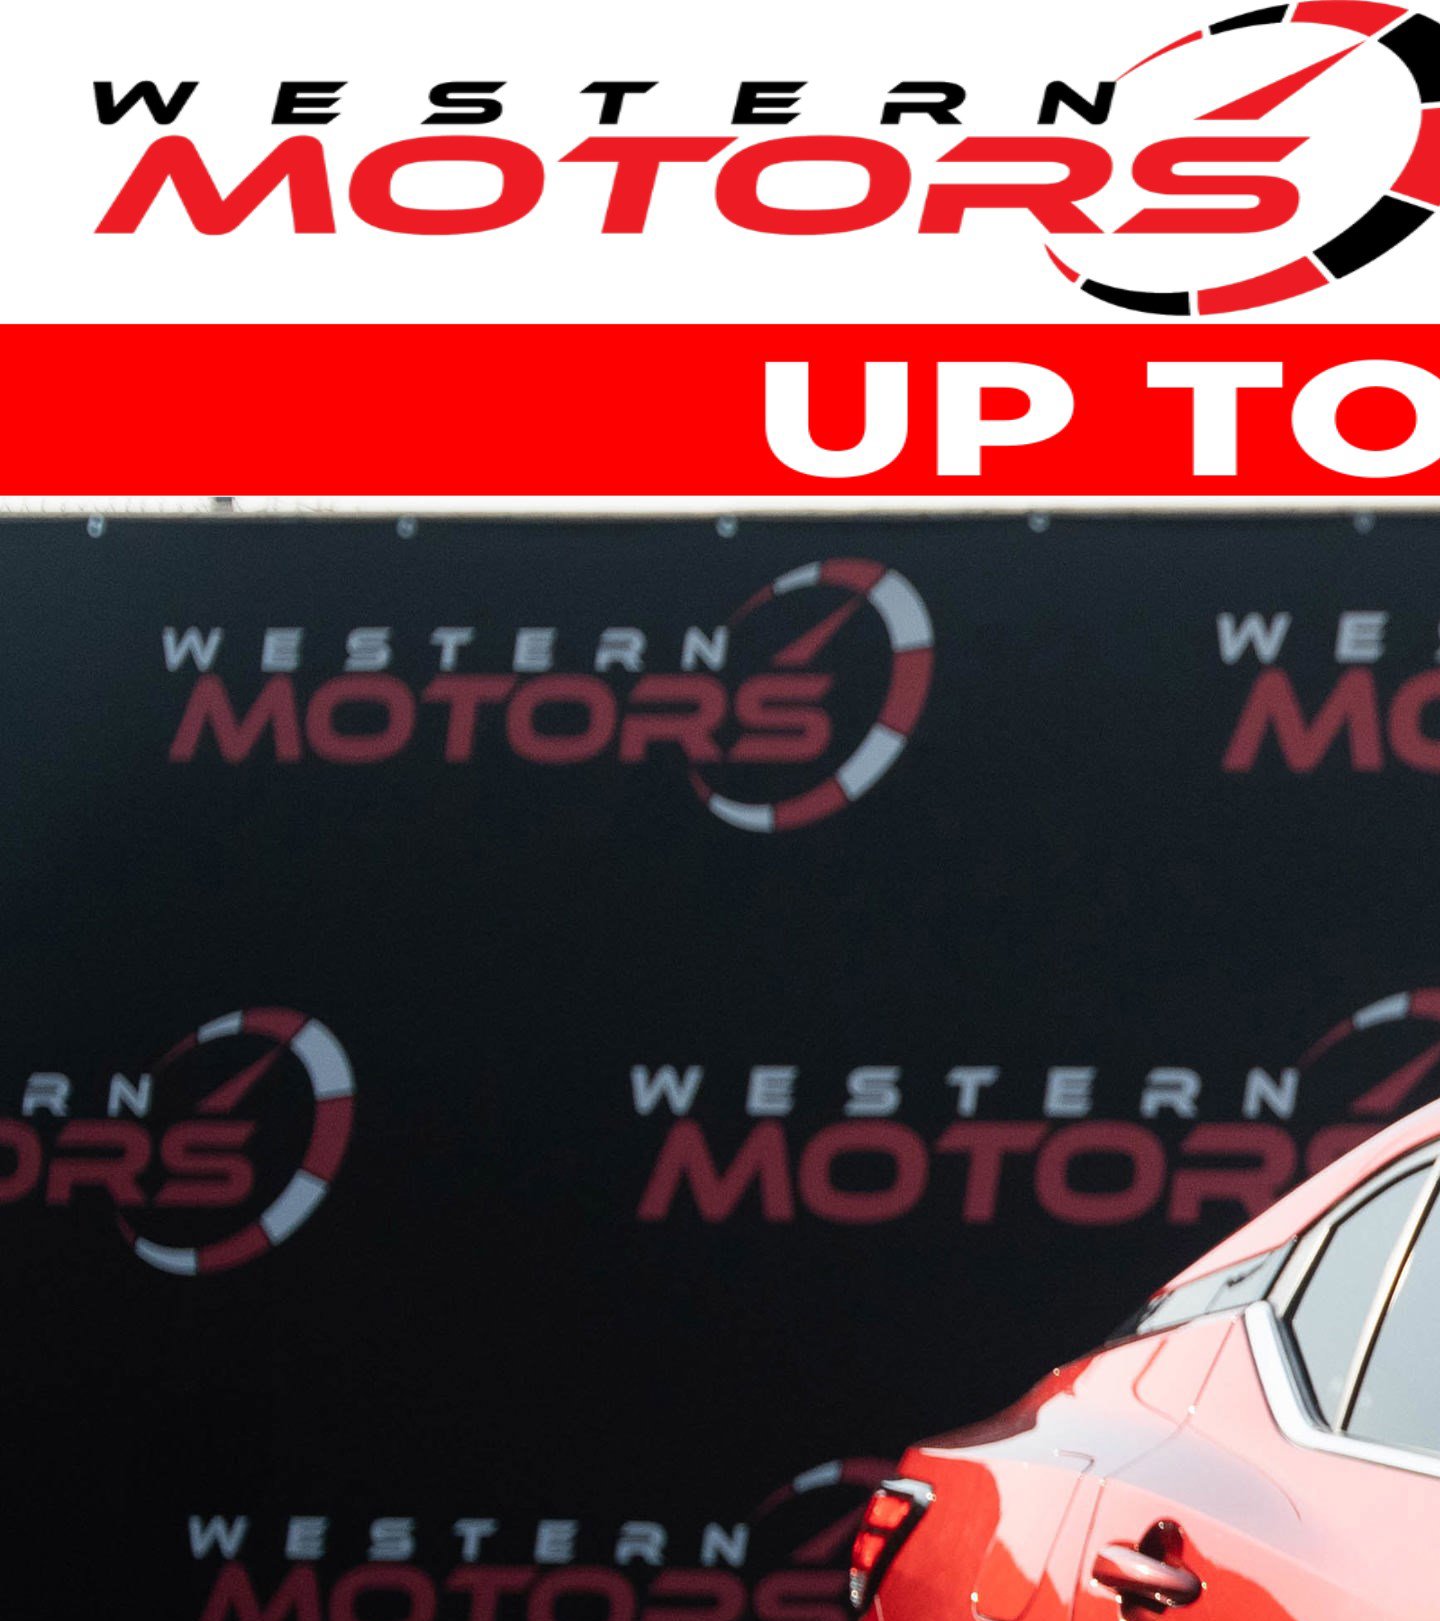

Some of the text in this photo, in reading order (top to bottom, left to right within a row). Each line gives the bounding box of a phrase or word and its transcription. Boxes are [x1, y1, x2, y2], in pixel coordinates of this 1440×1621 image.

[162, 626, 729, 672] WESTERN
[171, 675, 832, 762] MOTORS
[632, 1066, 1300, 1118] WESTERN
[637, 1119, 1385, 1226] MOTOR
[190, 1518, 748, 1564] WESTERN
